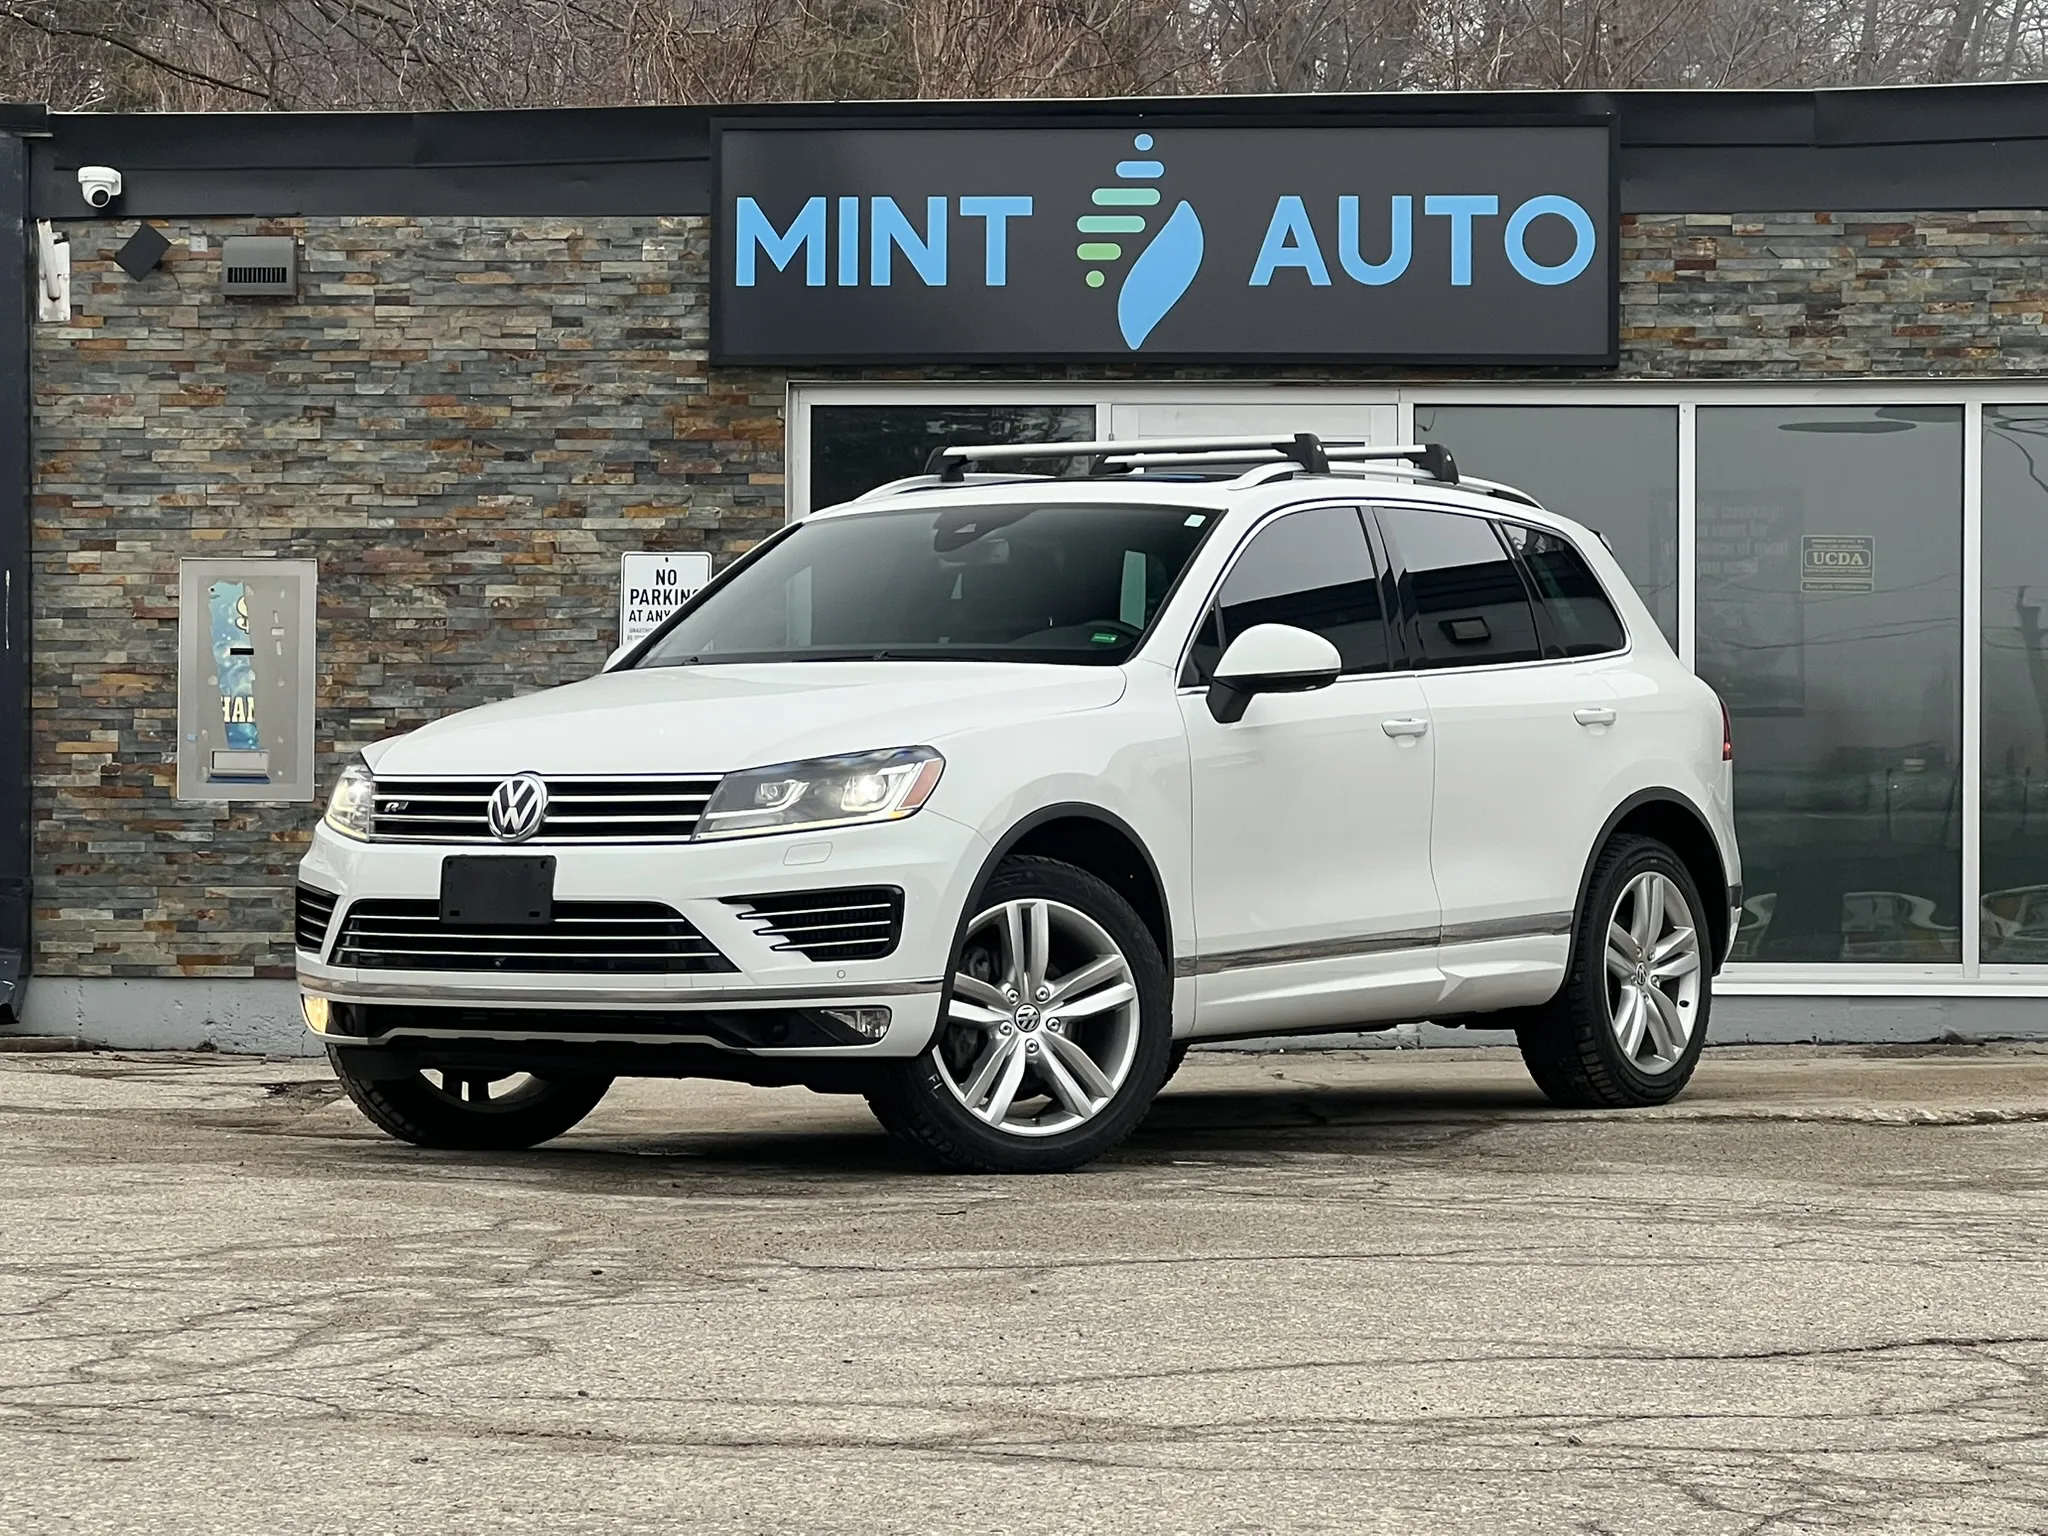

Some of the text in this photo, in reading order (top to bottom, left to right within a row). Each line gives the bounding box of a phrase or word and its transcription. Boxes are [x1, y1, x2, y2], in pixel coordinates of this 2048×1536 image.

[736, 194, 1596, 287] MINT AUTO
[1812, 551, 1865, 567] UCDA
[655, 568, 678, 586] NO
[629, 588, 701, 606] PARKIN
[628, 609, 671, 622] AT ANY
